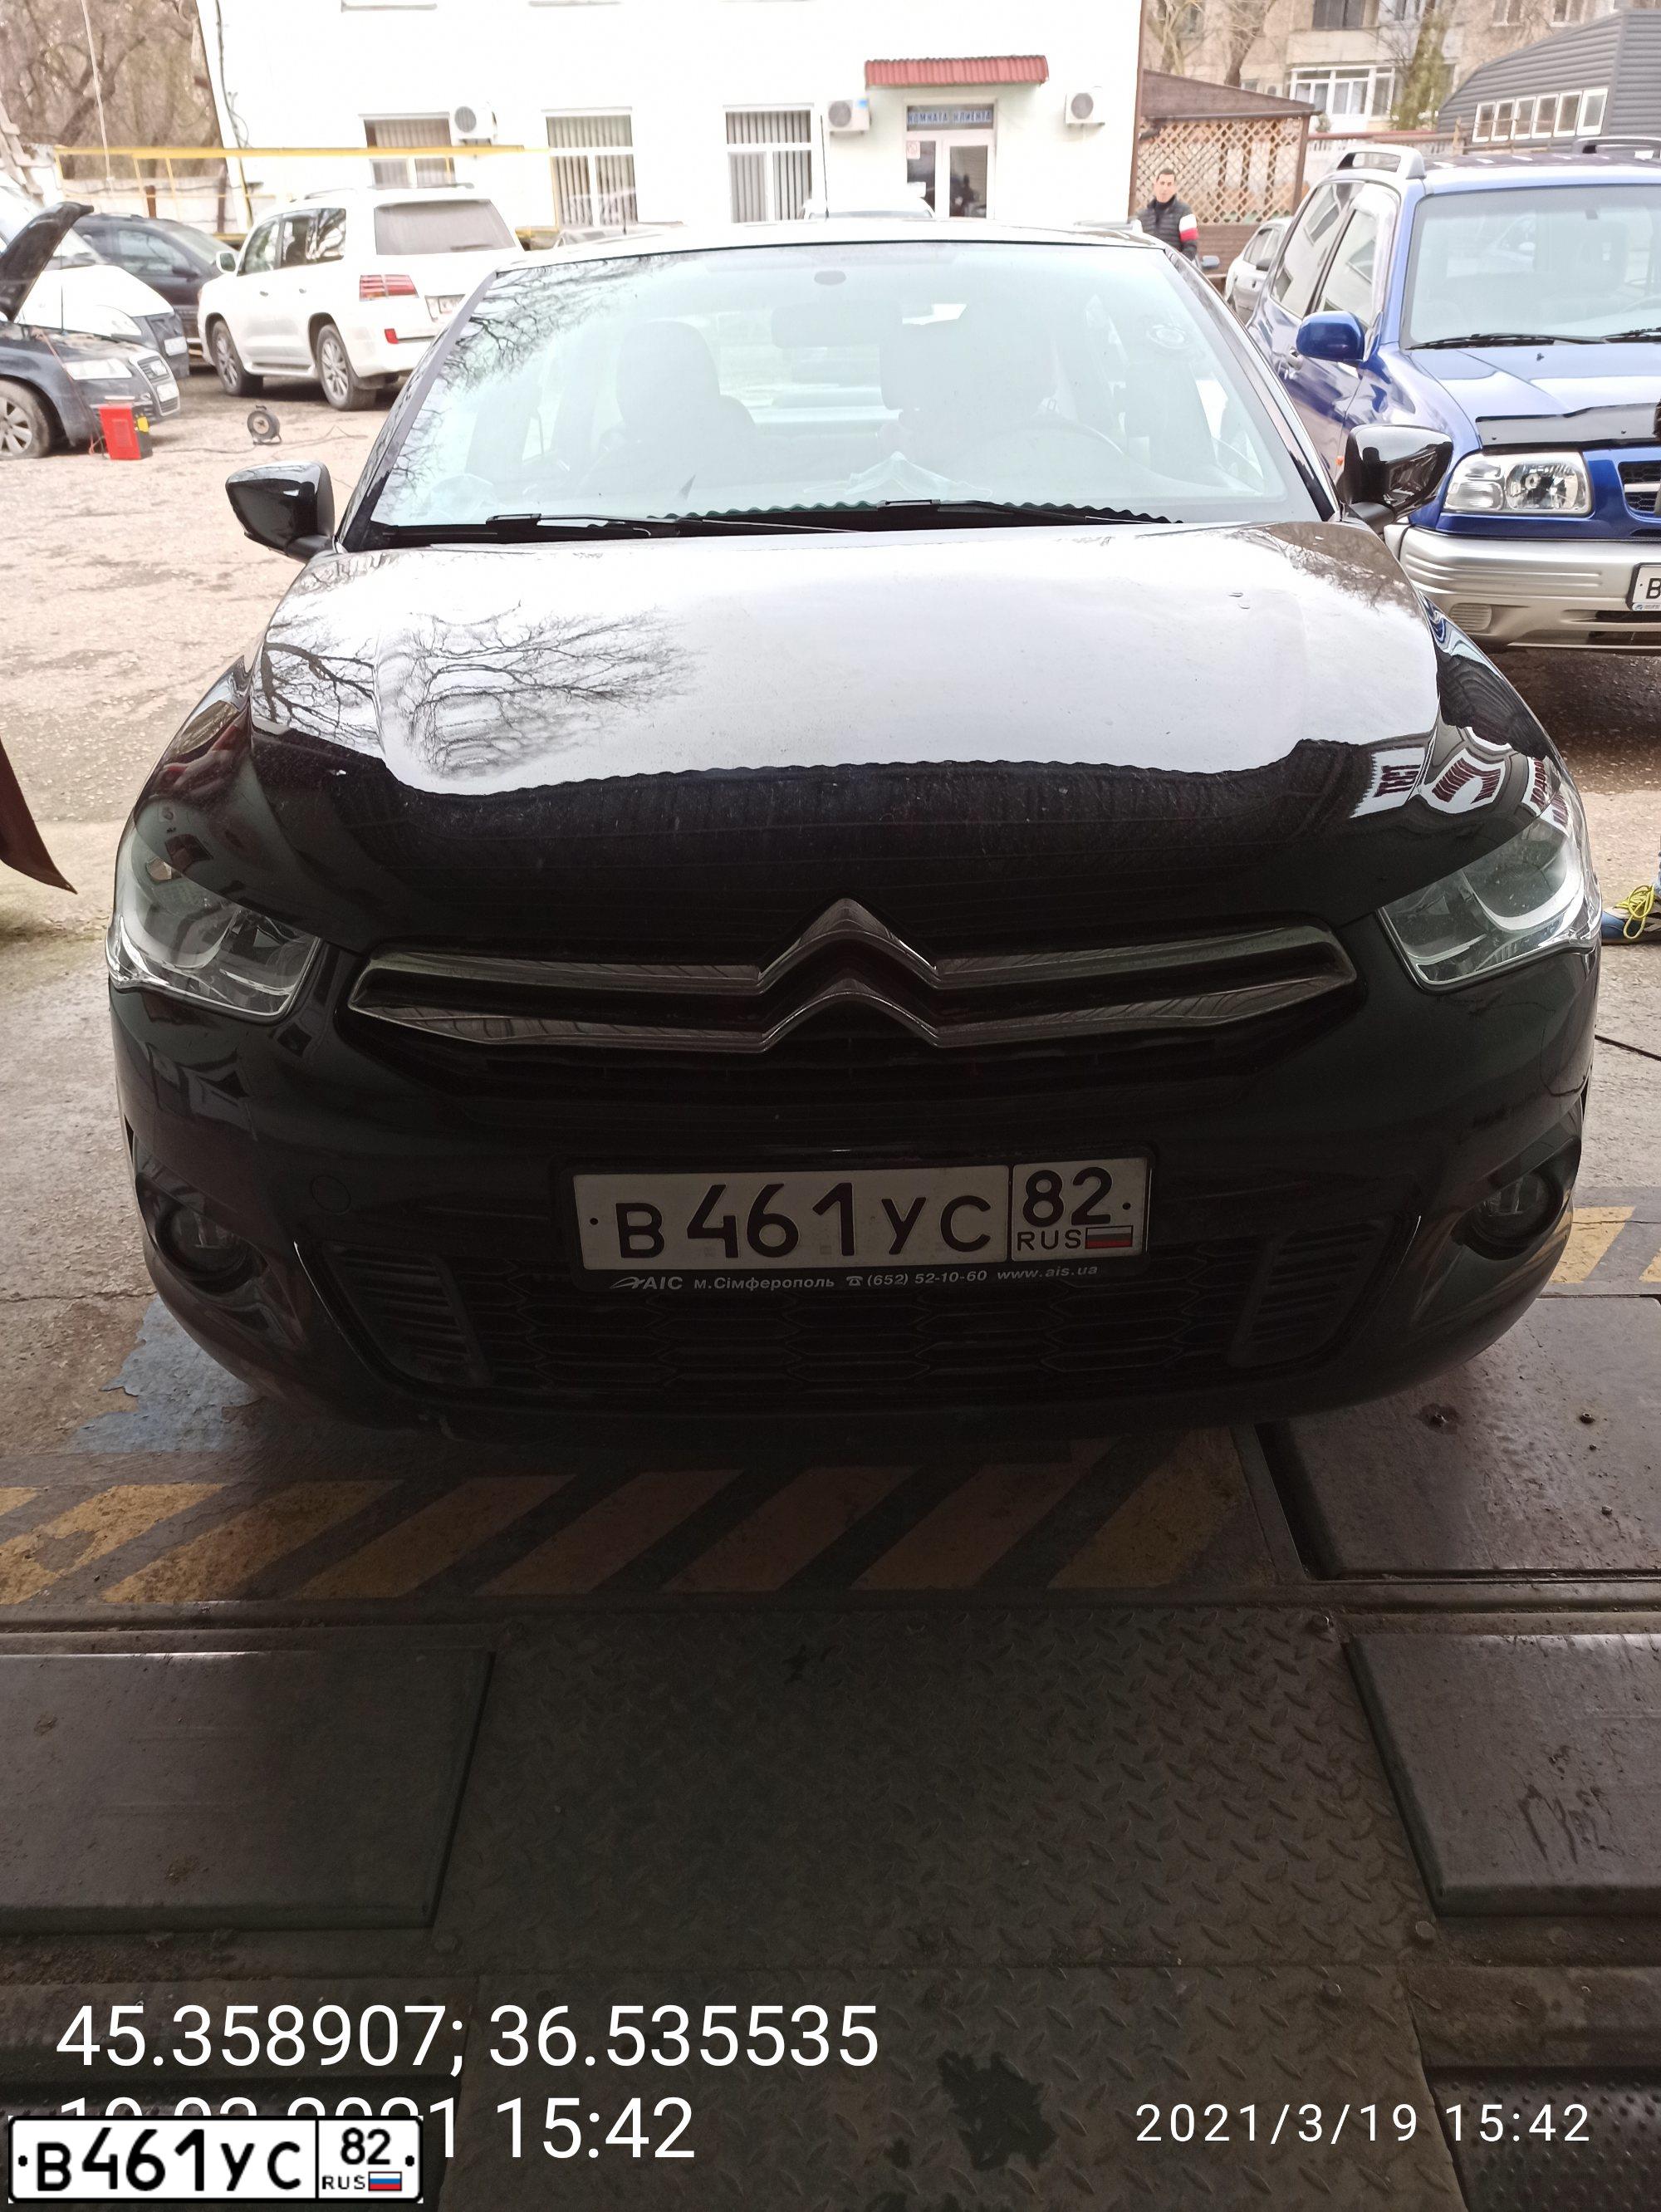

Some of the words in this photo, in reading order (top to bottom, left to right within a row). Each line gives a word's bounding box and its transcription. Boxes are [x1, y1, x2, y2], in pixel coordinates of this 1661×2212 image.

[1022, 1166, 1112, 1226] 82
[1017, 1229, 1082, 1252] RUS
[866, 1273, 909, 1287] (652)
[914, 1270, 988, 1284] 52-10-60
[997, 1265, 1099, 1281] www.ais.ua
